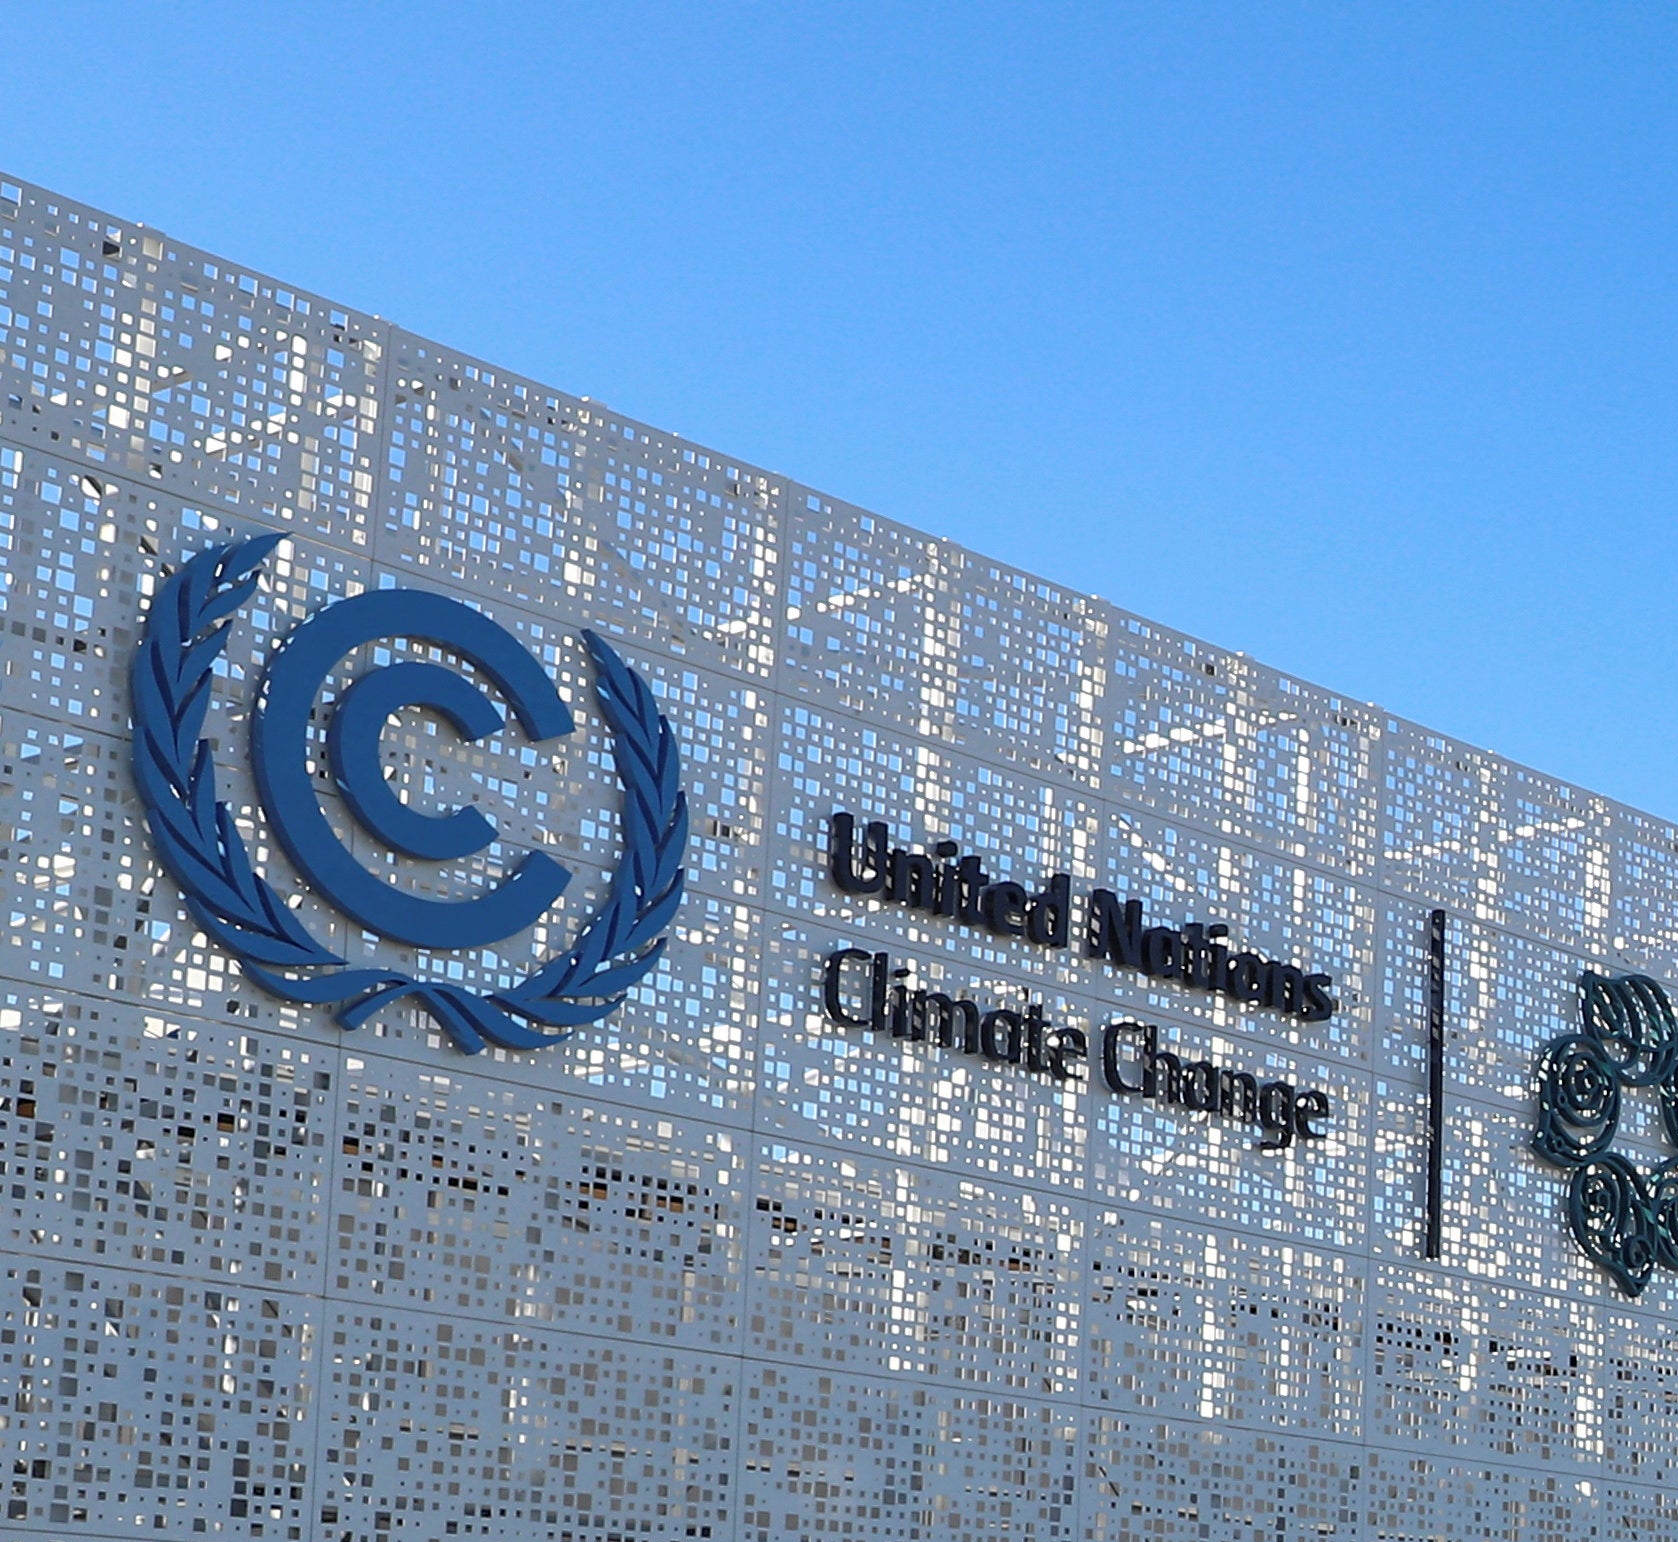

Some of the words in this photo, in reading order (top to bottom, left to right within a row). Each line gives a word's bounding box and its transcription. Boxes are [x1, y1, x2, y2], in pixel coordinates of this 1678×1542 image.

[829, 812, 1071, 948] United
[1088, 888, 1333, 1022] Nations
[824, 948, 1088, 1081] Climate
[1101, 1021, 1330, 1151] Change
